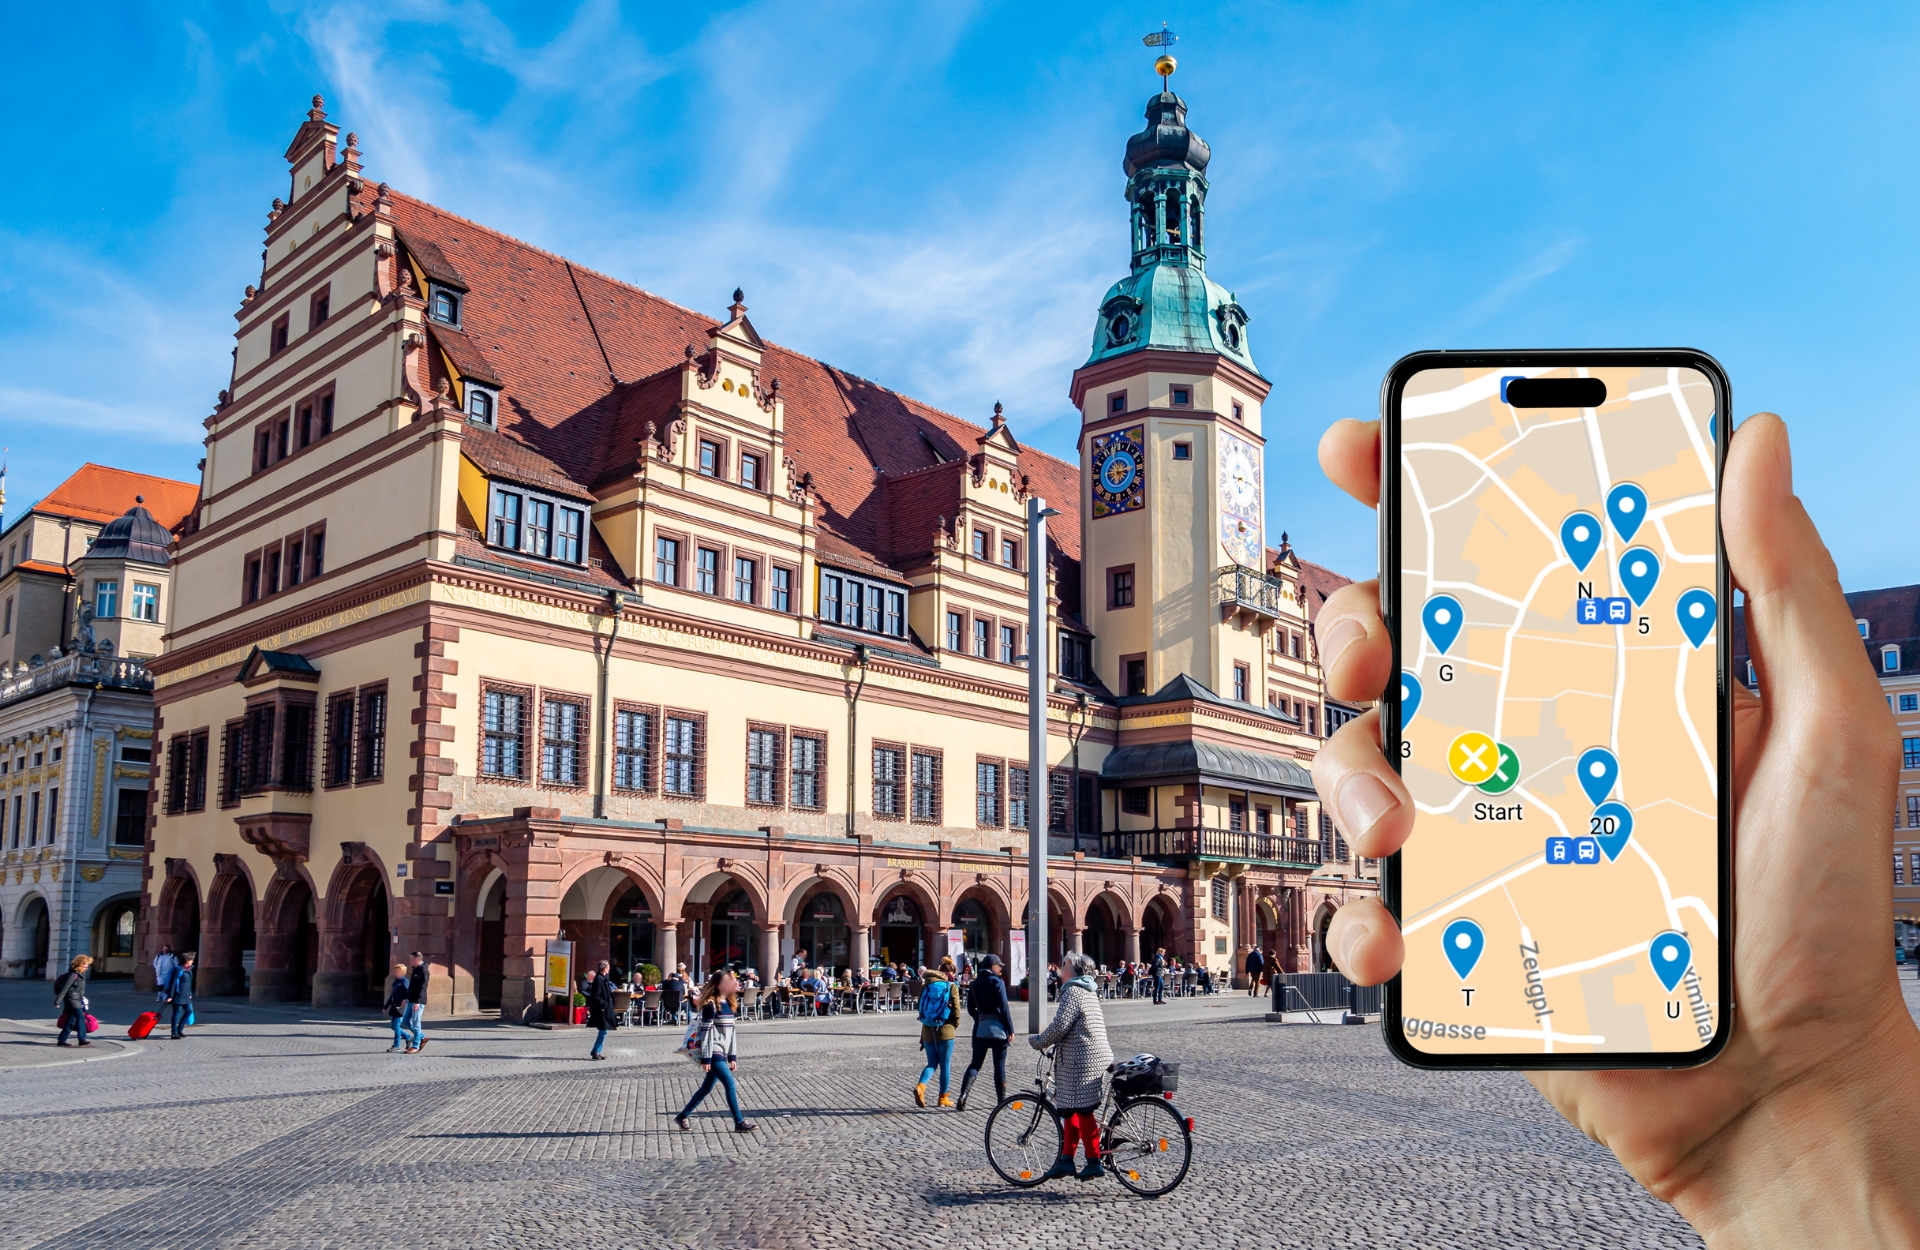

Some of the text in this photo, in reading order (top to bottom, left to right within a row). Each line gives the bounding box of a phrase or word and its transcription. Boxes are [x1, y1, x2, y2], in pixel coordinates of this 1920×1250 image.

[1577, 581, 1593, 599] N
[442, 584, 489, 607] NACH
[622, 622, 668, 642] HERRN
[288, 616, 332, 642] REGIERUNG
[1638, 617, 1650, 635] 5
[1439, 664, 1454, 682] G
[1401, 740, 1411, 758] 3
[1473, 802, 1523, 822] Start
[1590, 817, 1615, 836] 20
[887, 858, 926, 869] BRASSERIE
[959, 863, 1003, 874] RESTAURANT
[1519, 941, 1554, 1024] Zeugpl.
[1682, 931, 1714, 1043] ximilia
[1461, 989, 1475, 1007] T
[1667, 1001, 1681, 1019] U
